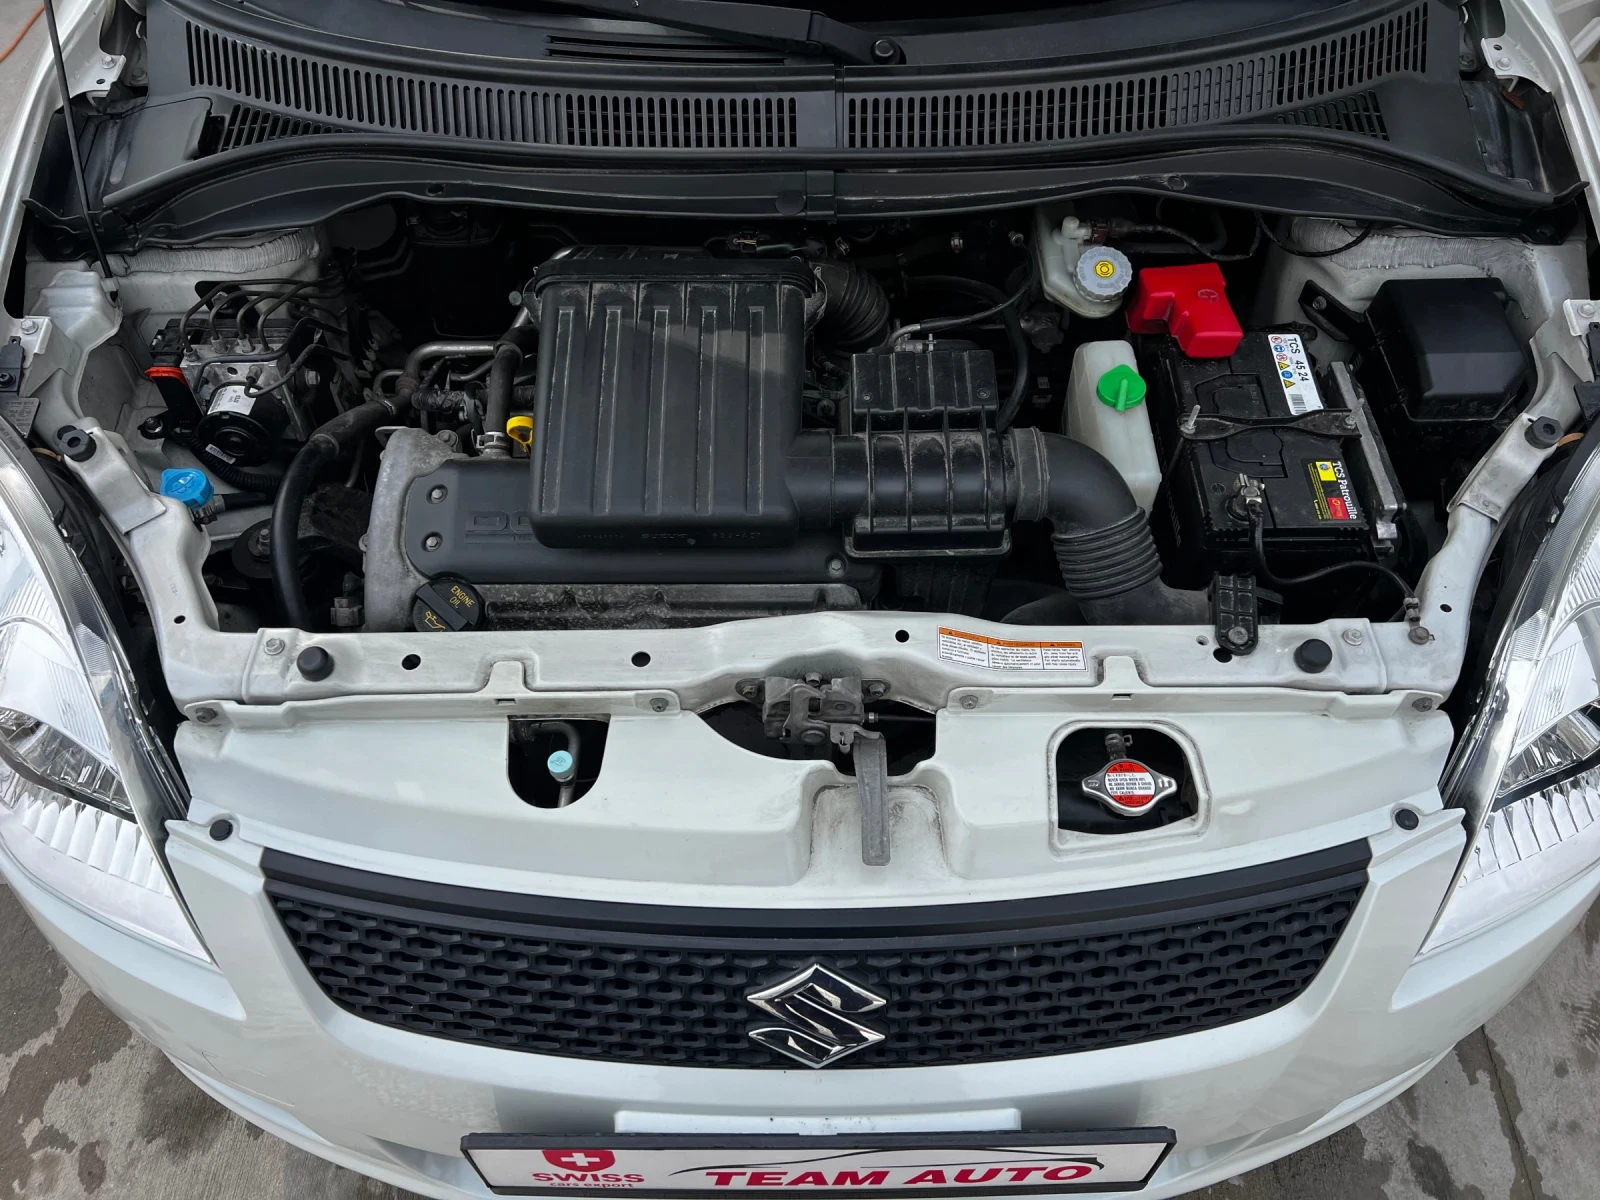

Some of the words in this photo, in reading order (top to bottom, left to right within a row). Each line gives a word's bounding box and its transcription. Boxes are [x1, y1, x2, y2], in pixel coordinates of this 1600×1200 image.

[1287, 337, 1301, 354] TCS
[1294, 360, 1306, 370] 45
[1297, 372, 1310, 382] 24
[1332, 461, 1345, 478] TCS
[1337, 479, 1358, 520] Patrouille
[449, 596, 461, 609] OIL
[450, 585, 476, 608] ENGINE
[531, 1171, 646, 1183] SWISS
[705, 1171, 891, 1186] TEAM
[902, 1165, 1093, 1185] AUTO
